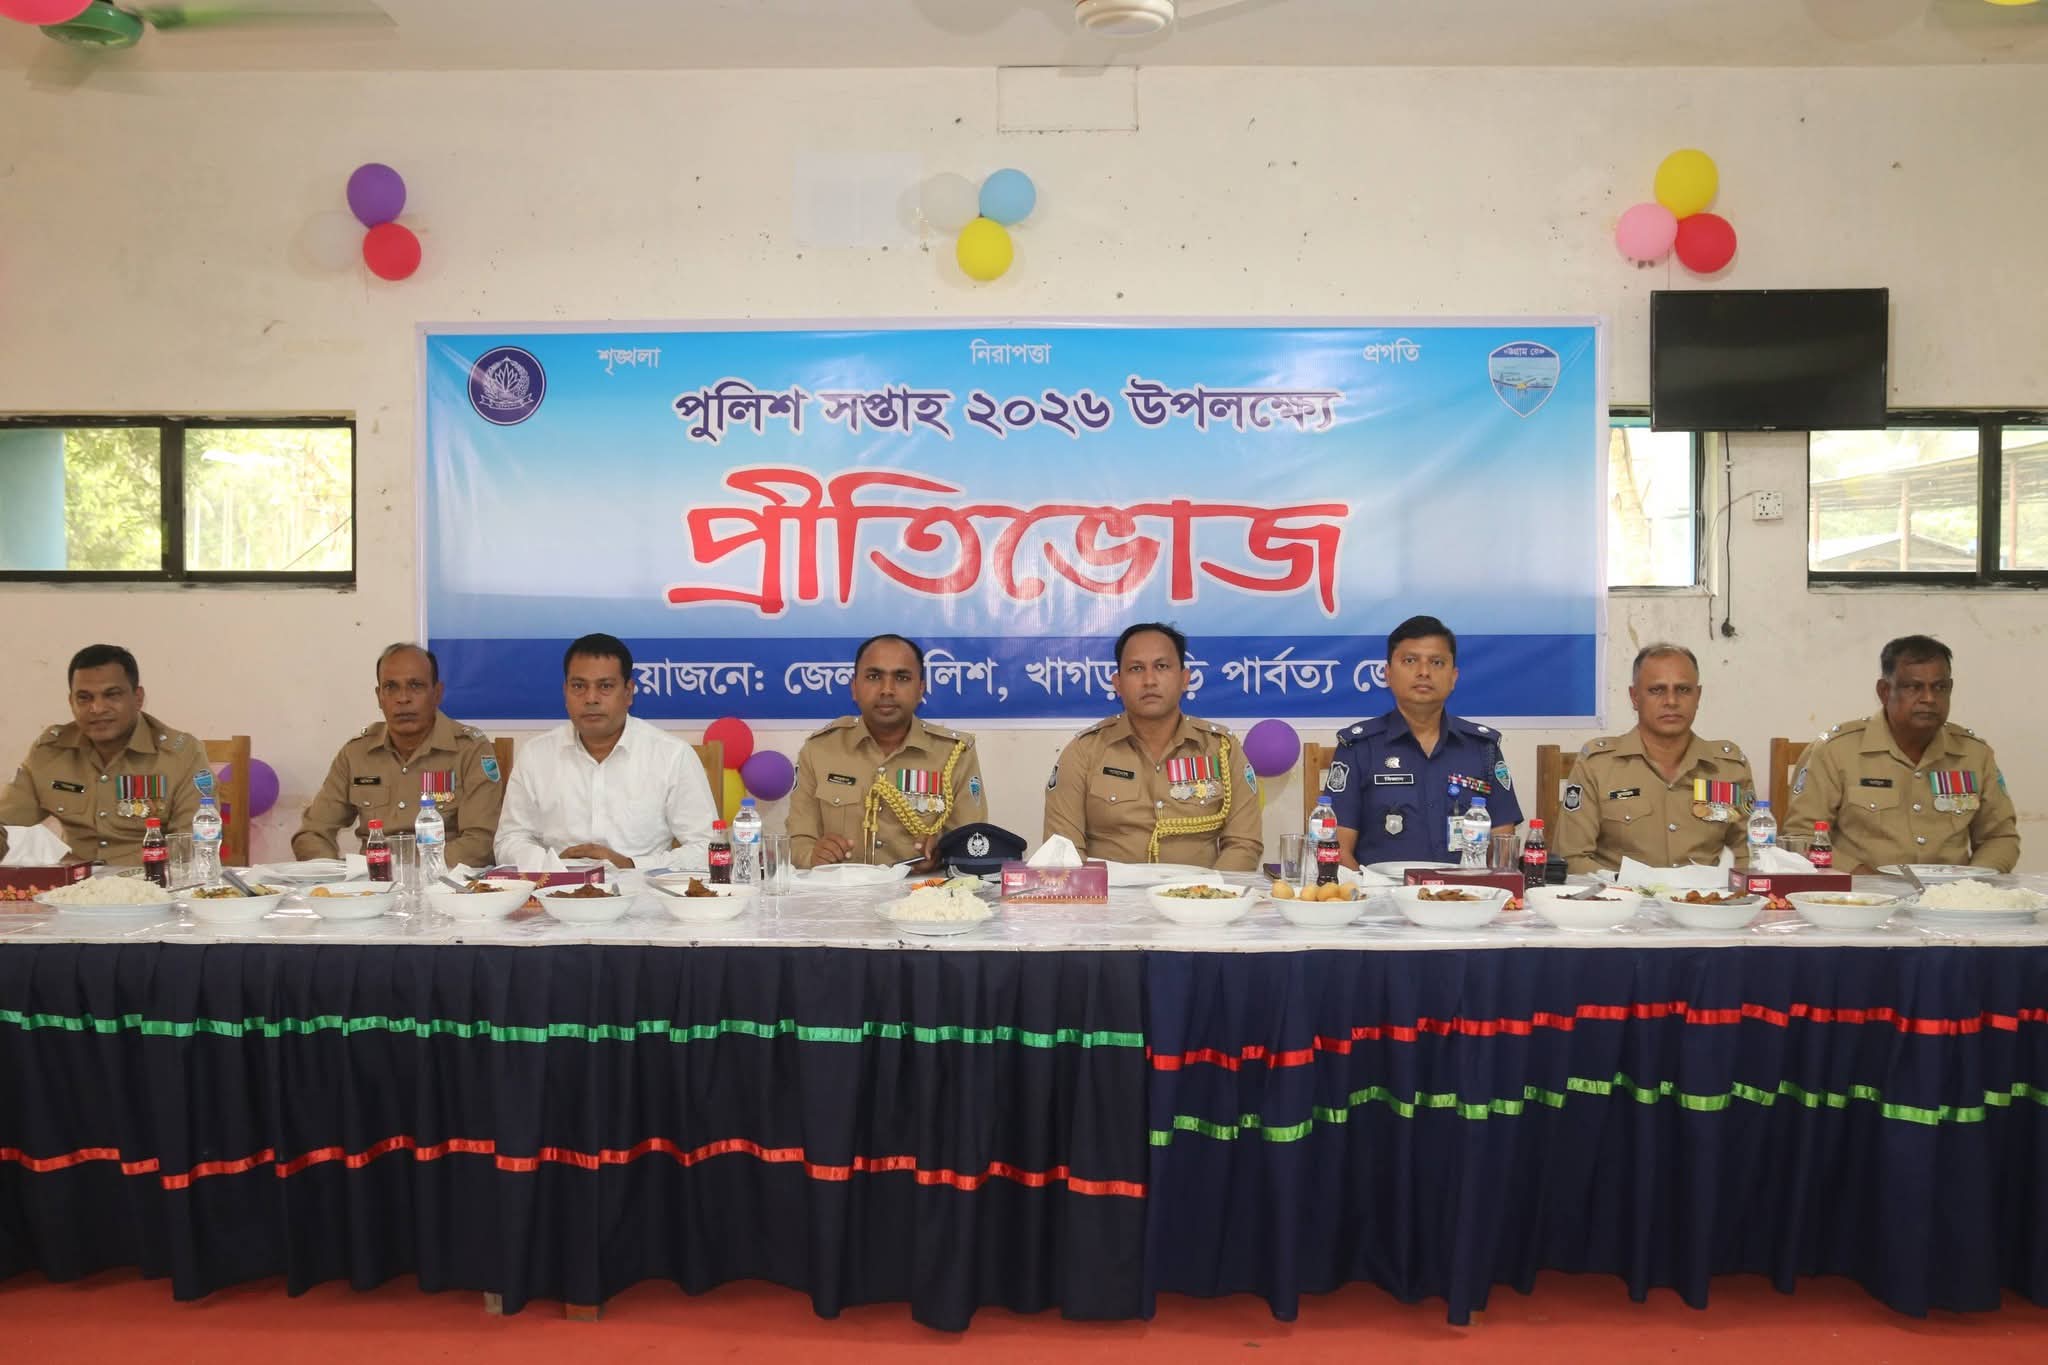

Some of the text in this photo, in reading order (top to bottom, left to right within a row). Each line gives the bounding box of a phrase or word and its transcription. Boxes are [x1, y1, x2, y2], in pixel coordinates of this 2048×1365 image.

[596, 337, 1422, 376] শৃঙ্খলা নিরাপত্তা প্রগতি
[674, 377, 1343, 443] পুলিশ সপ্তাহ ২০২৬ উপলক্ষ্যে
[667, 467, 1350, 615] প্রীতিভোজ
[784, 661, 855, 696] জেল
[1221, 646, 1341, 696] পার্বত্য
